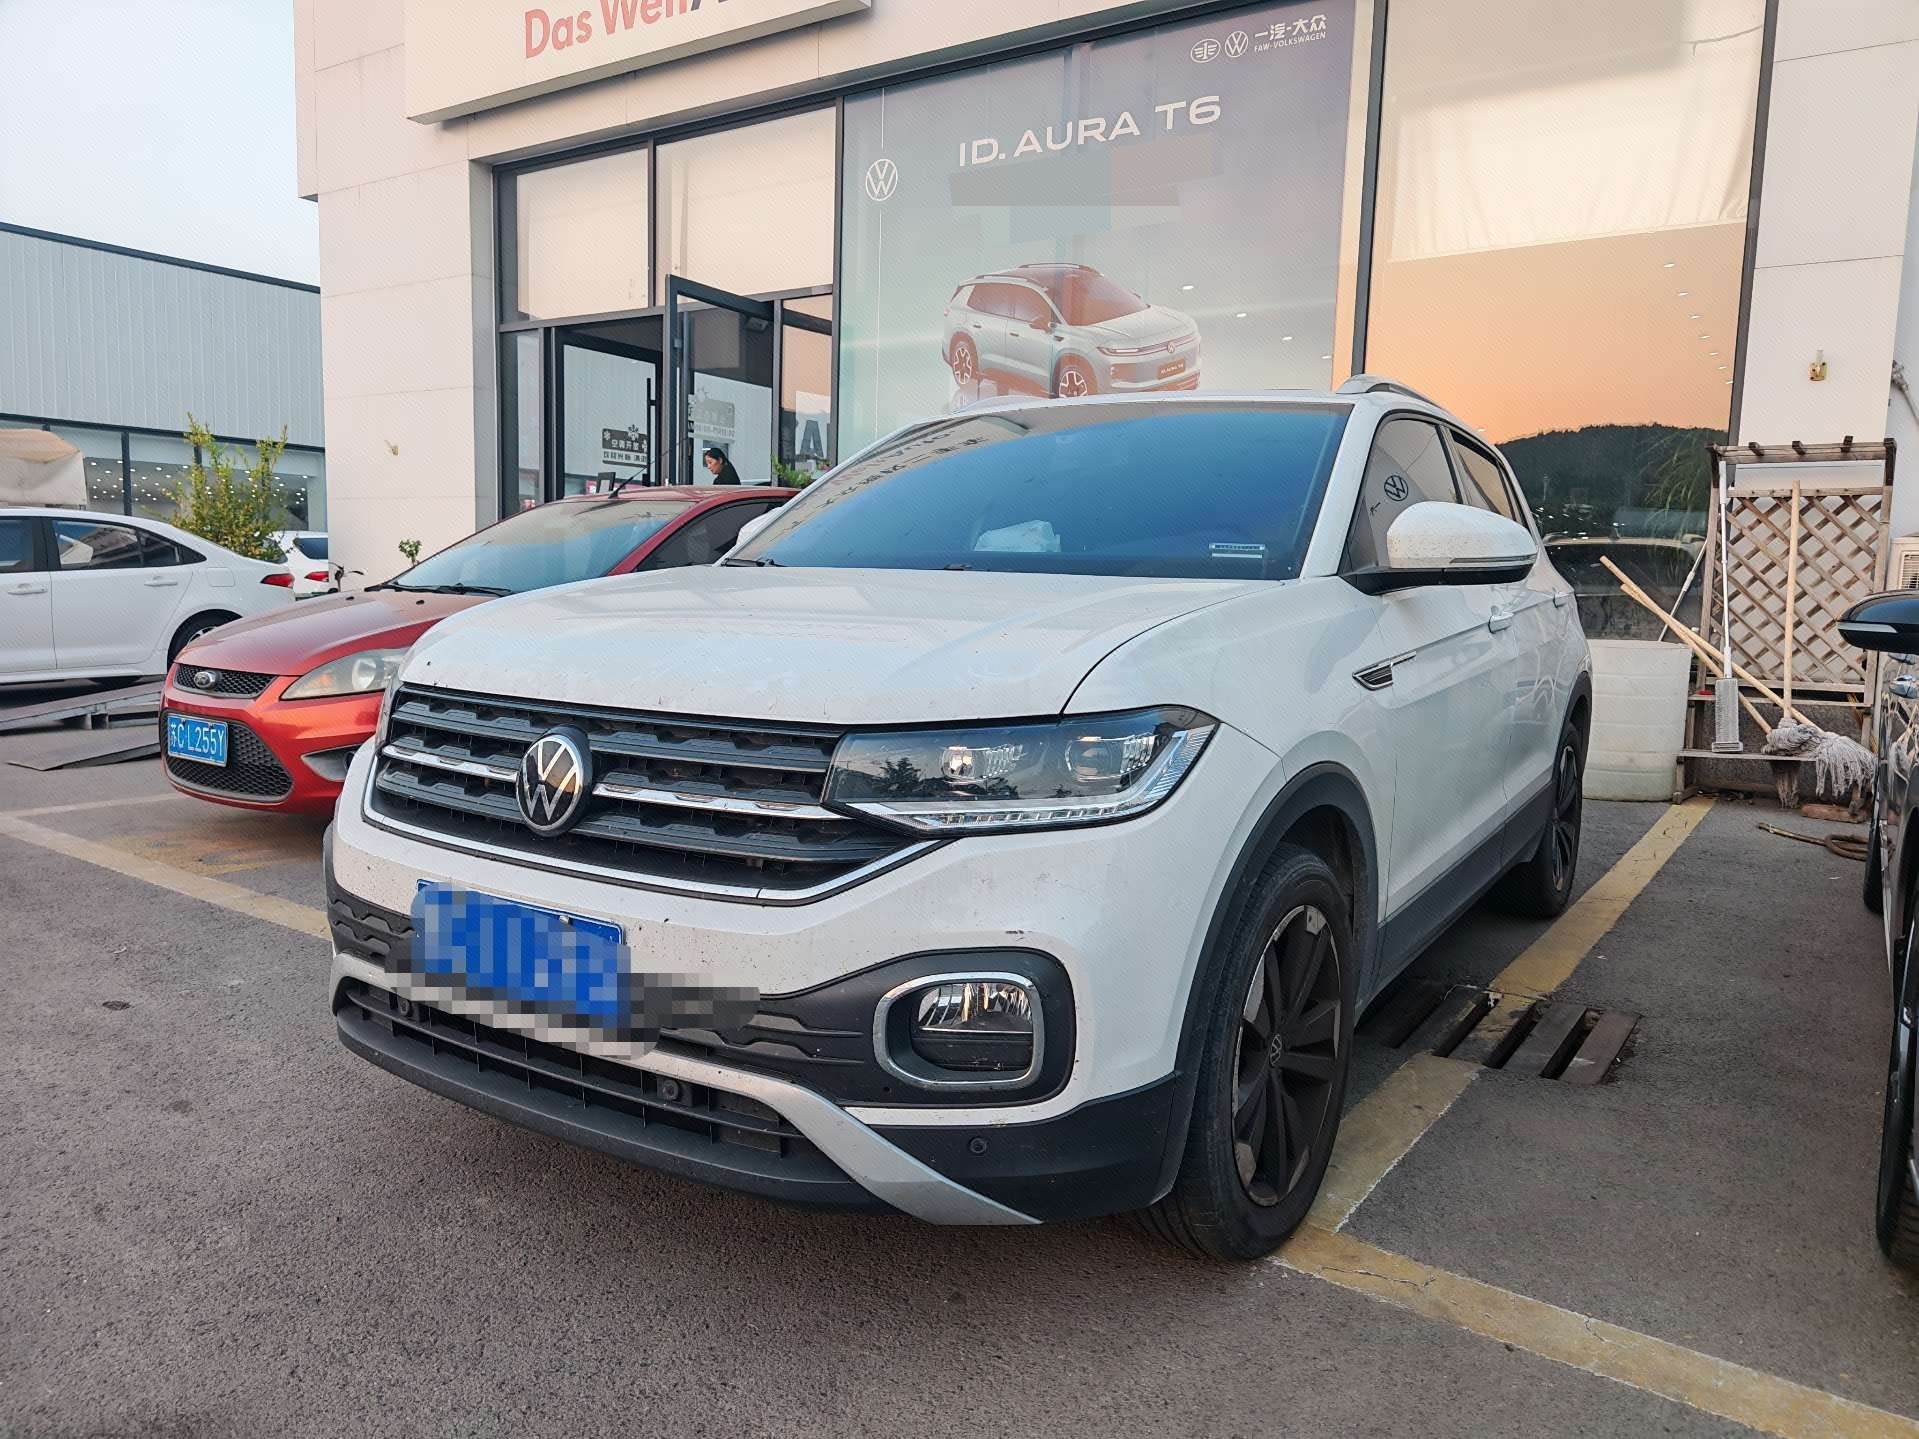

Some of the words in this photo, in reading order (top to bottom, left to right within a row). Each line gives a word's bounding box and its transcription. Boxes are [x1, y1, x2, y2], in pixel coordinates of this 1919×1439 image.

[524, 8, 593, 58] Das
[1254, 31, 1327, 53] FAW-VOLKSWAGEN
[959, 137, 1006, 167] ID.
[1012, 111, 1141, 158] AURA
[1154, 95, 1221, 130] T6
